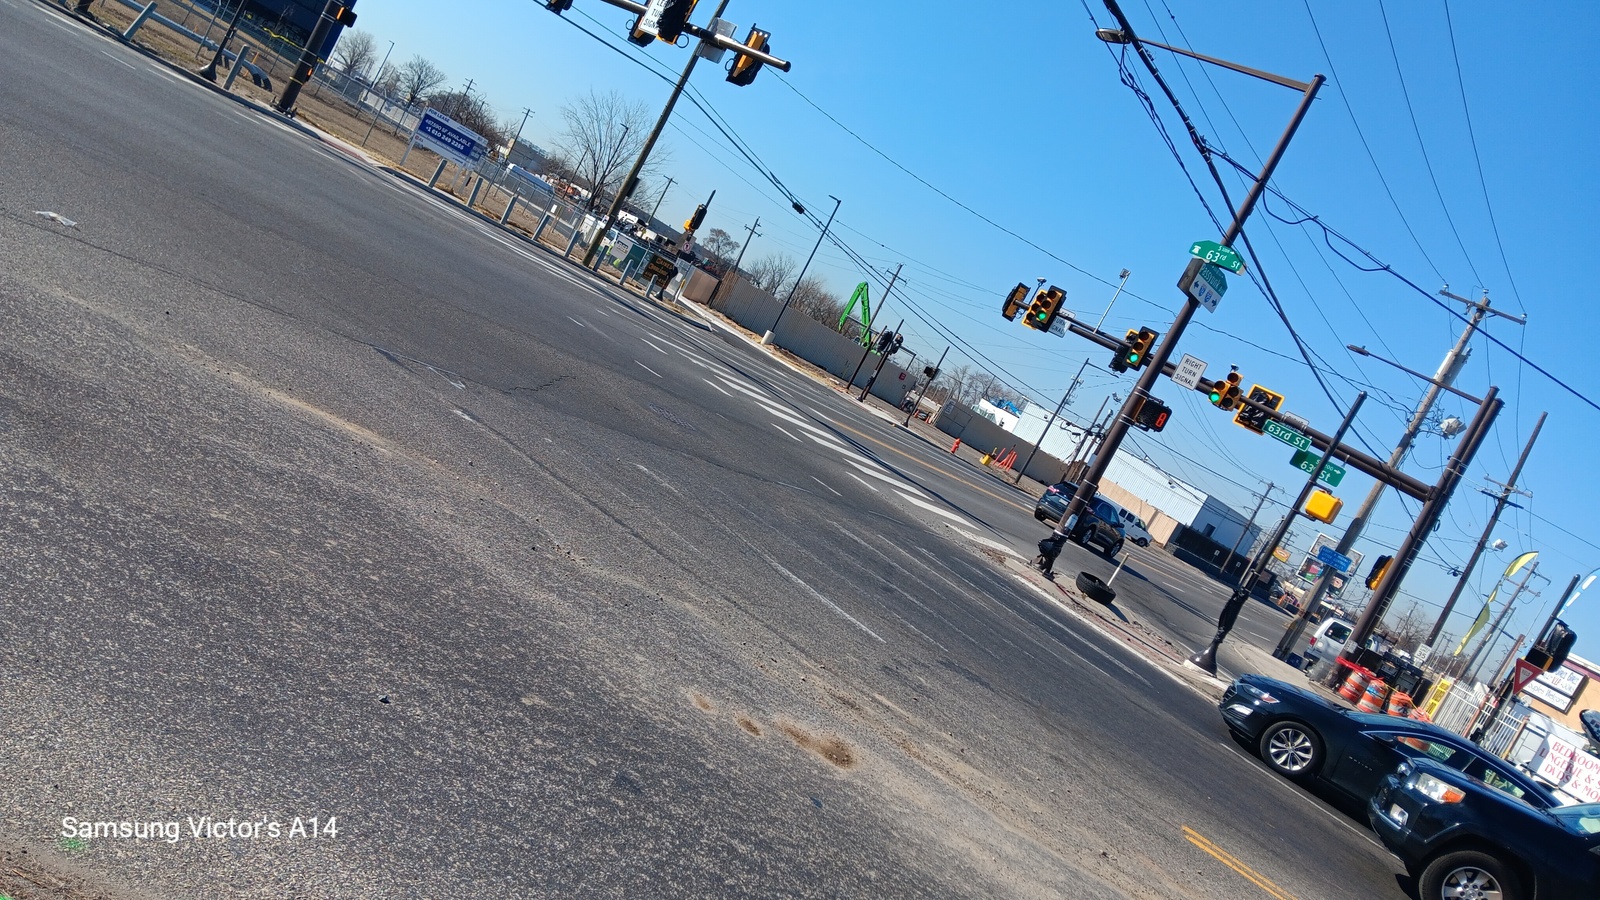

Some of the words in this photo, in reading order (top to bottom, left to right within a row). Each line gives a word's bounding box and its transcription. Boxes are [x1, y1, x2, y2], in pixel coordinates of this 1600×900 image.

[437, 112, 450, 122] LEASE
[447, 131, 471, 147] AVAILABLE
[1206, 250, 1227, 262] 63rd
[1231, 261, 1240, 269] St
[1185, 359, 1203, 370] RIGHT
[1182, 367, 1197, 377] TURN
[1175, 374, 1194, 386] SIGNAL
[1268, 424, 1292, 440] 63rd
[1293, 438, 1305, 448] St
[1319, 471, 1330, 481] St
[1416, 651, 1426, 659] 35
[1552, 741, 1600, 774] BEDROOM
[1539, 748, 1583, 778] LINGERIE
[1584, 774, 1594, 784] &
[1544, 764, 1571, 783] DVDS
[1571, 780, 1581, 789] &
